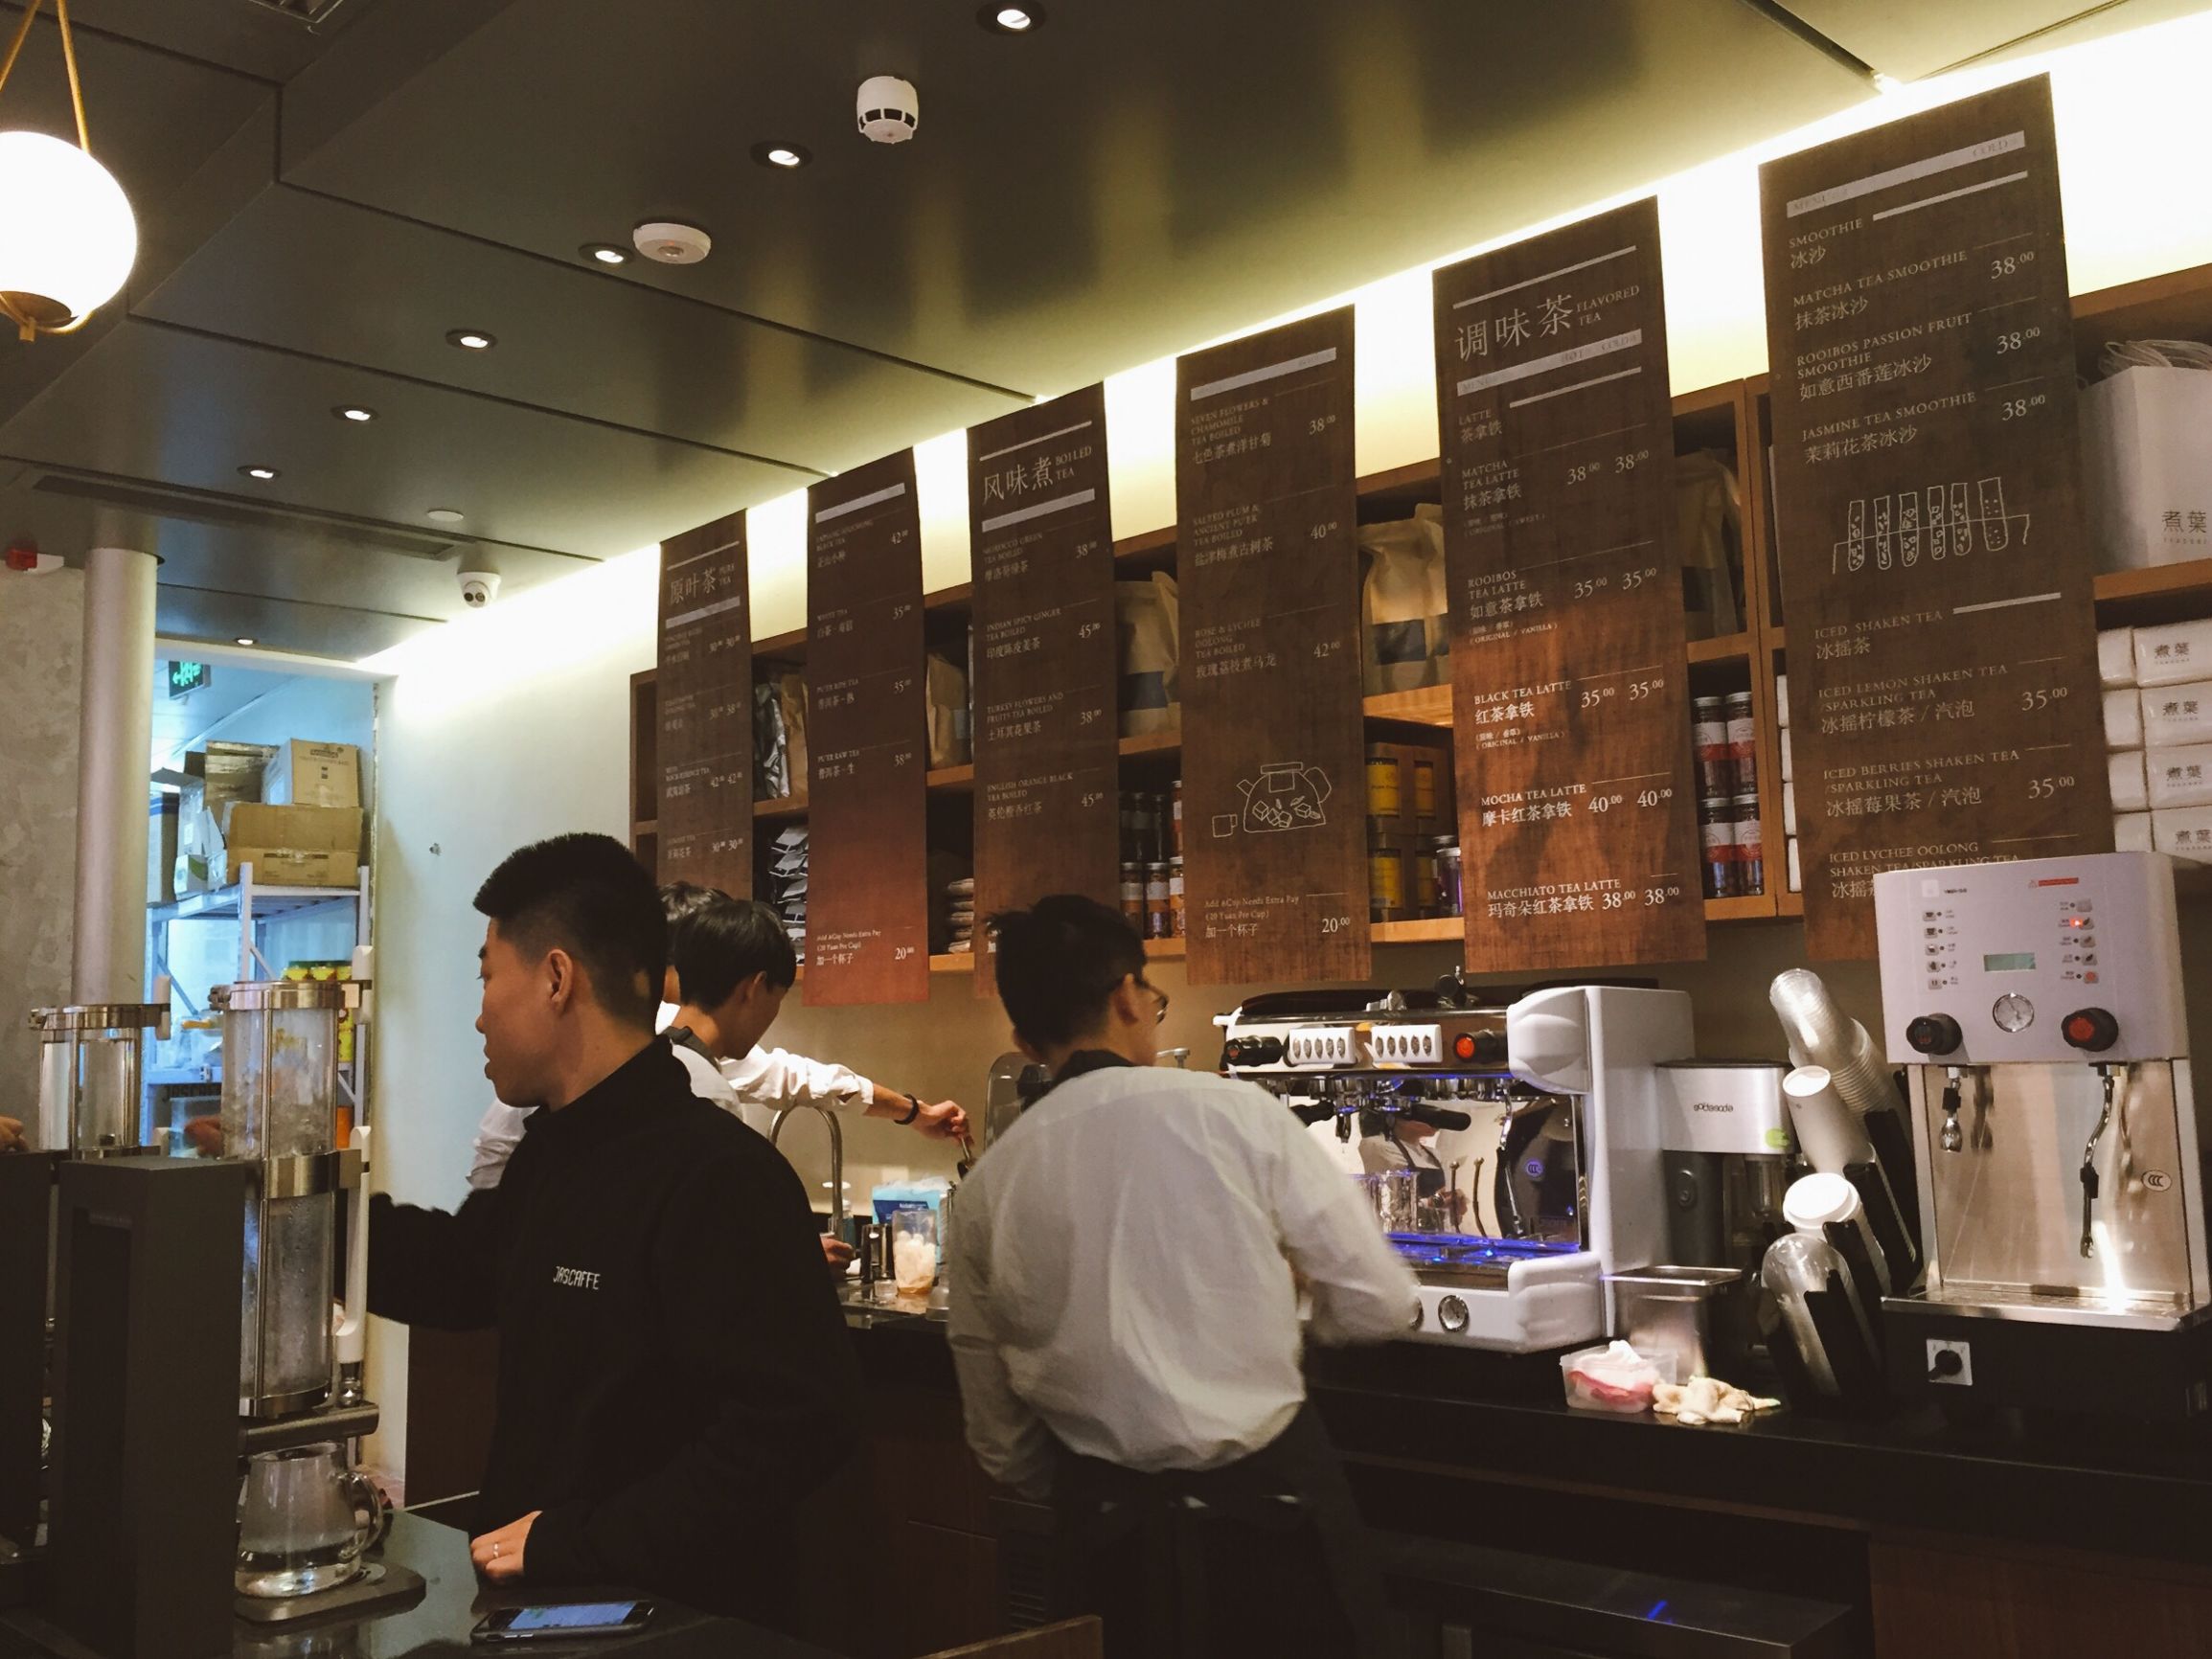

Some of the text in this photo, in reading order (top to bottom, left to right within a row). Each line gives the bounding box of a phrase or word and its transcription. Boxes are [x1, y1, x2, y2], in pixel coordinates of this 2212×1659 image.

[1789, 217, 1863, 249] SMOOTHIE
[1790, 245, 1826, 269] 冰沙
[1991, 250, 2035, 280] 38.00
[1793, 249, 1969, 307] MATCHA TEA SMOOTHIE
[1576, 284, 1640, 313] FLAVORED
[1580, 313, 1602, 327] TEA
[1794, 295, 1869, 330] 抹茶冰沙
[1454, 294, 1572, 362] 调味茶
[1796, 312, 1973, 367] ROOIBOS PASSION FRUIT
[1996, 327, 2041, 355] 38.00
[1797, 351, 1873, 379] SMOOTHIE
[1799, 352, 1932, 401] 如意西番莲冰沙
[1459, 409, 1493, 425] LATTE
[1801, 391, 1977, 443] JASMINE TEA SMOOTHIE
[2001, 394, 2046, 421] 38.00
[1191, 435, 1207, 445] TEA
[1460, 419, 1502, 443] 茶拿铁
[1055, 445, 1092, 466] BOILED
[1804, 424, 1918, 466] 茉莉花茶冰沙
[1056, 467, 1075, 480] TEA
[1462, 460, 1508, 479] MATCHA
[1614, 450, 1650, 473] 38.00
[983, 456, 1053, 505] 风味煮
[1463, 467, 1520, 490] TEA LATTE
[1463, 483, 1522, 511] 抹茶拿铁
[2161, 511, 2207, 534] 煮葉
[1195, 536, 1210, 546] TEA
[669, 568, 716, 604] 原叶茶
[1468, 569, 1517, 589] ROOIBOS
[1469, 580, 1527, 600] TEA LATTE
[1574, 577, 1608, 599] 35.00
[1622, 568, 1657, 590] 35.00
[1470, 591, 1543, 621] 如意茶拿铁
[1814, 610, 1944, 640] ICED SHAKEN TEA
[1196, 649, 1212, 659] TEA
[1815, 636, 1871, 660] 冰摇茶
[1474, 680, 1572, 705] BLACK TEA LATTE
[1629, 679, 1665, 701] 35.00
[1818, 664, 2008, 699] ICED LEMON SHAKEN TEA
[1581, 687, 1615, 709] 35.00
[1909, 688, 1937, 700] TEA
[2021, 686, 2068, 712] 35.00
[1474, 700, 1536, 725] 红茶拿铁
[1820, 698, 1975, 735] 冰摇柠檬茶 汽泡
[1823, 749, 2020, 781] ICED BERRIES SHAKEN TEA
[1915, 772, 1943, 785] TEA
[2027, 775, 2075, 800] 35.00
[1481, 784, 1586, 807] MOCHA TEA LATTE
[1588, 795, 1623, 813] 40.00
[1637, 788, 1673, 807] 40.00
[1826, 785, 1982, 818] 冰摇莓果茶 汽泡
[1482, 801, 1572, 827] 摩卡红茶拿铁
[1829, 842, 1979, 864] ICED LYCHEE OOLONG
[1830, 865, 1881, 877] SHAKEN
[1266, 896, 1284, 904] Extra
[1286, 895, 1299, 905] Pay
[1487, 879, 1622, 900] MACCHIATO TEA LATTE
[1601, 891, 1636, 910] 38.00
[1644, 887, 1679, 906] 38.00
[1488, 894, 1594, 919] 玛奇朵红茶拿铁
[1205, 922, 1258, 939] 加一个杯子
